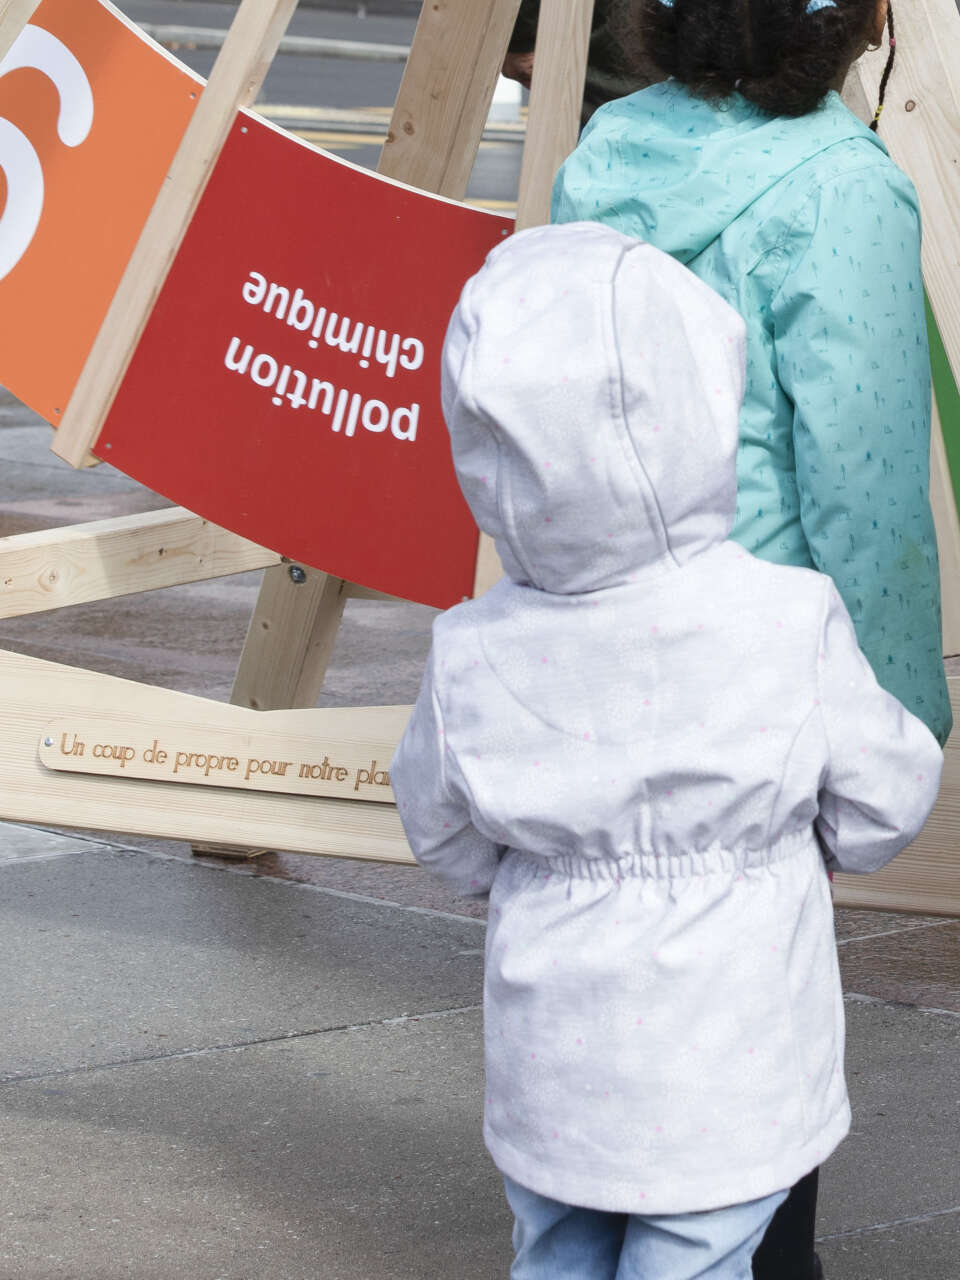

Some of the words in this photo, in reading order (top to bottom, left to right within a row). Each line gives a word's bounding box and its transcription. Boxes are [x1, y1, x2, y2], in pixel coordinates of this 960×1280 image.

[242, 271, 425, 378] chimique
[224, 336, 420, 442] pollution
[60, 732, 86, 757] Un
[92, 743, 136, 768] coup
[143, 739, 168, 764] de
[173, 751, 239, 777] propre
[244, 758, 293, 780] pour
[297, 756, 349, 782] notre
